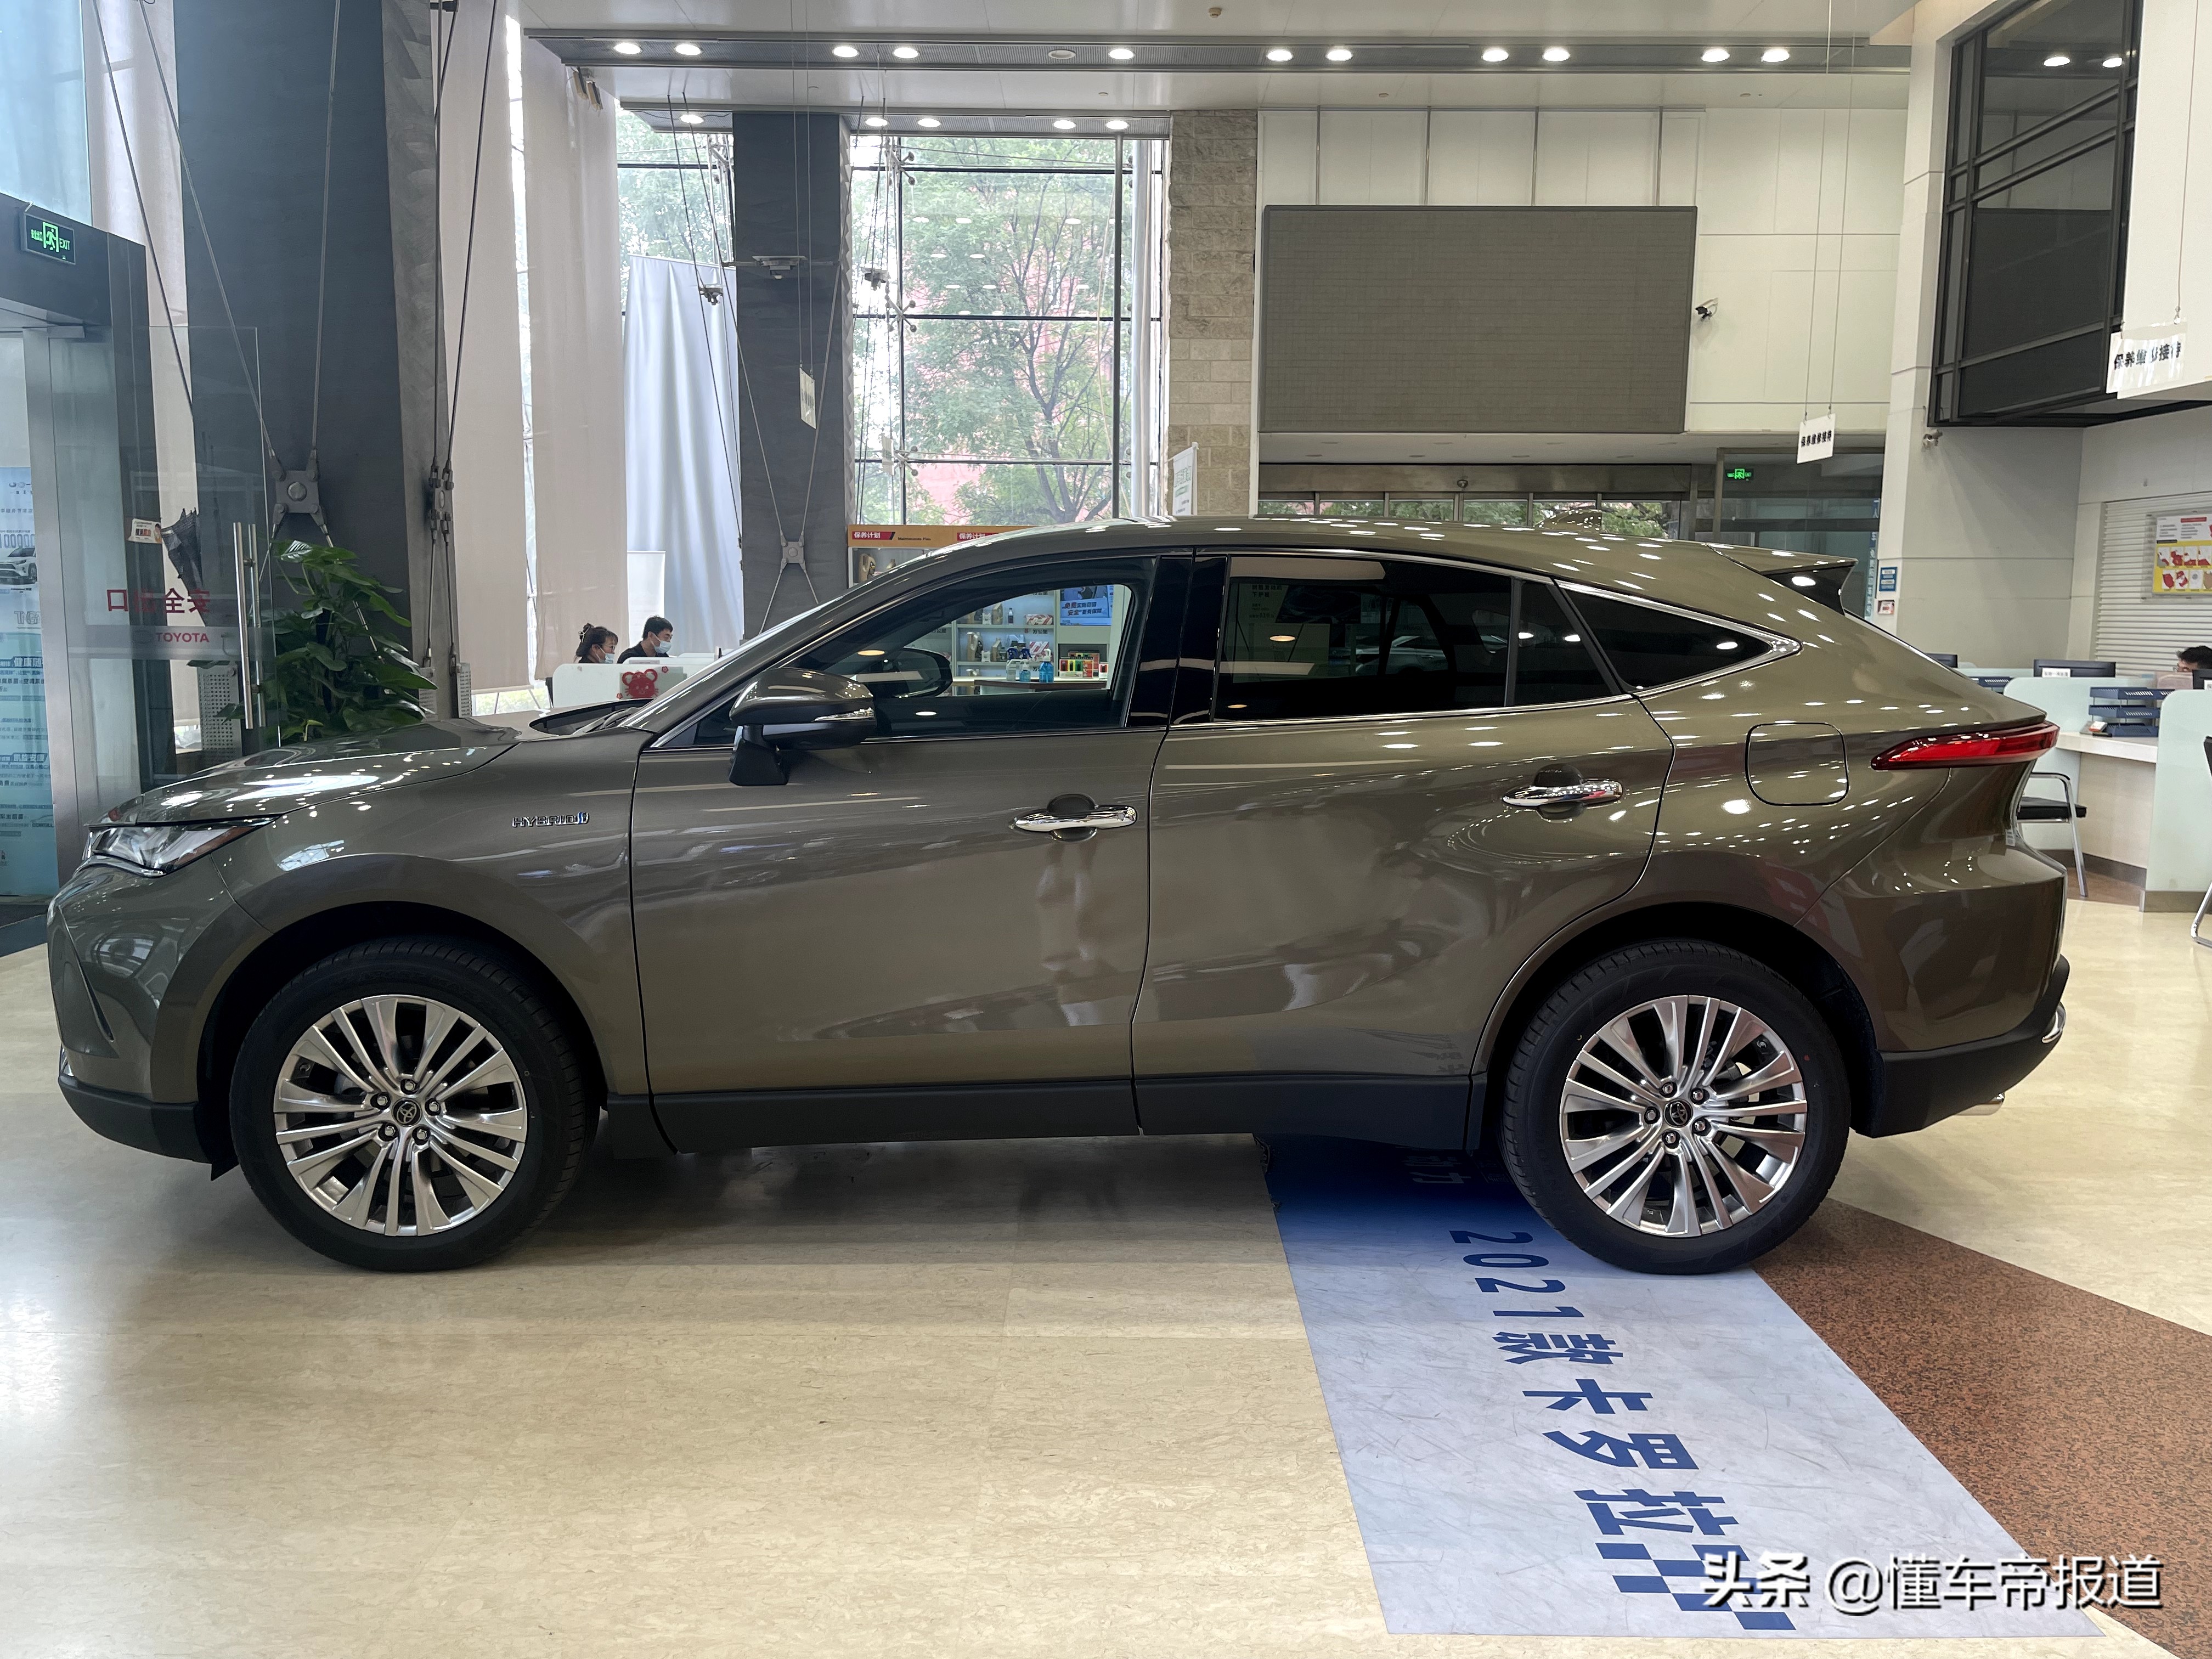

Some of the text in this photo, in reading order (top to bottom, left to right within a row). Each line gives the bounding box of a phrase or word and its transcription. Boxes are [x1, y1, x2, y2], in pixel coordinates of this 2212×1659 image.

[59, 238, 70, 250] EXIT
[156, 633, 210, 642] TOYOTA
[512, 815, 577, 827] HYBRID
[1449, 1230, 1739, 1536] 2021款卡罗拉
